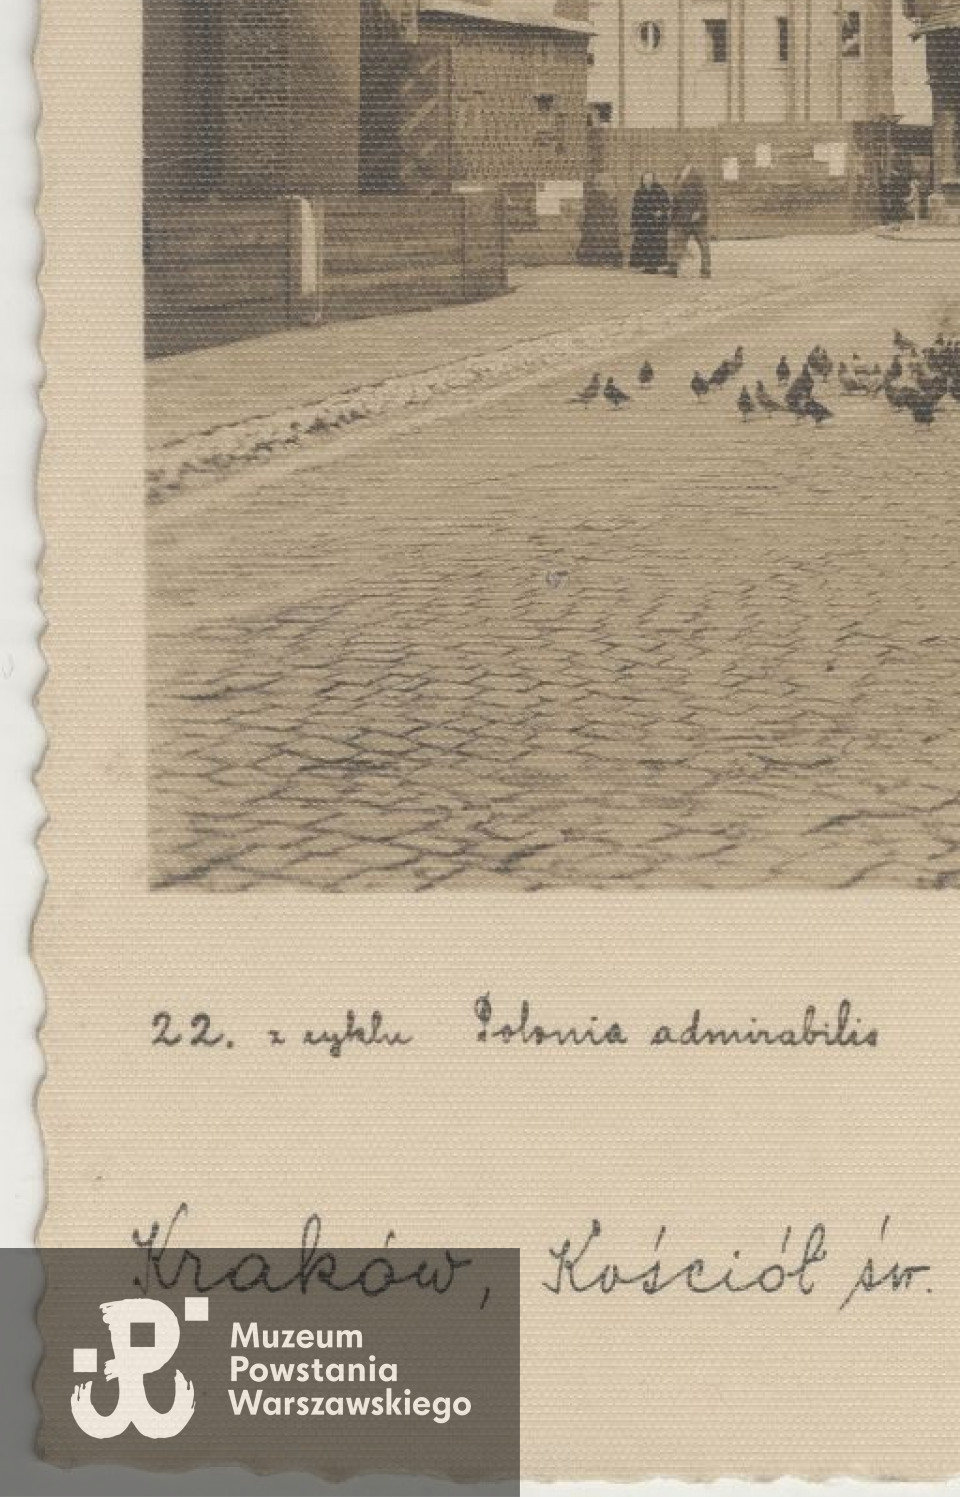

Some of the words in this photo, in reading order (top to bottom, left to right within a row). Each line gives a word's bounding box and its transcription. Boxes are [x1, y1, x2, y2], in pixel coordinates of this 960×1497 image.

[151, 1011, 235, 1050] 22.
[474, 991, 628, 1047] Polonia
[650, 999, 880, 1048] admirabilis
[131, 1202, 491, 1310] Kraków,
[542, 1218, 828, 1294] Kościół
